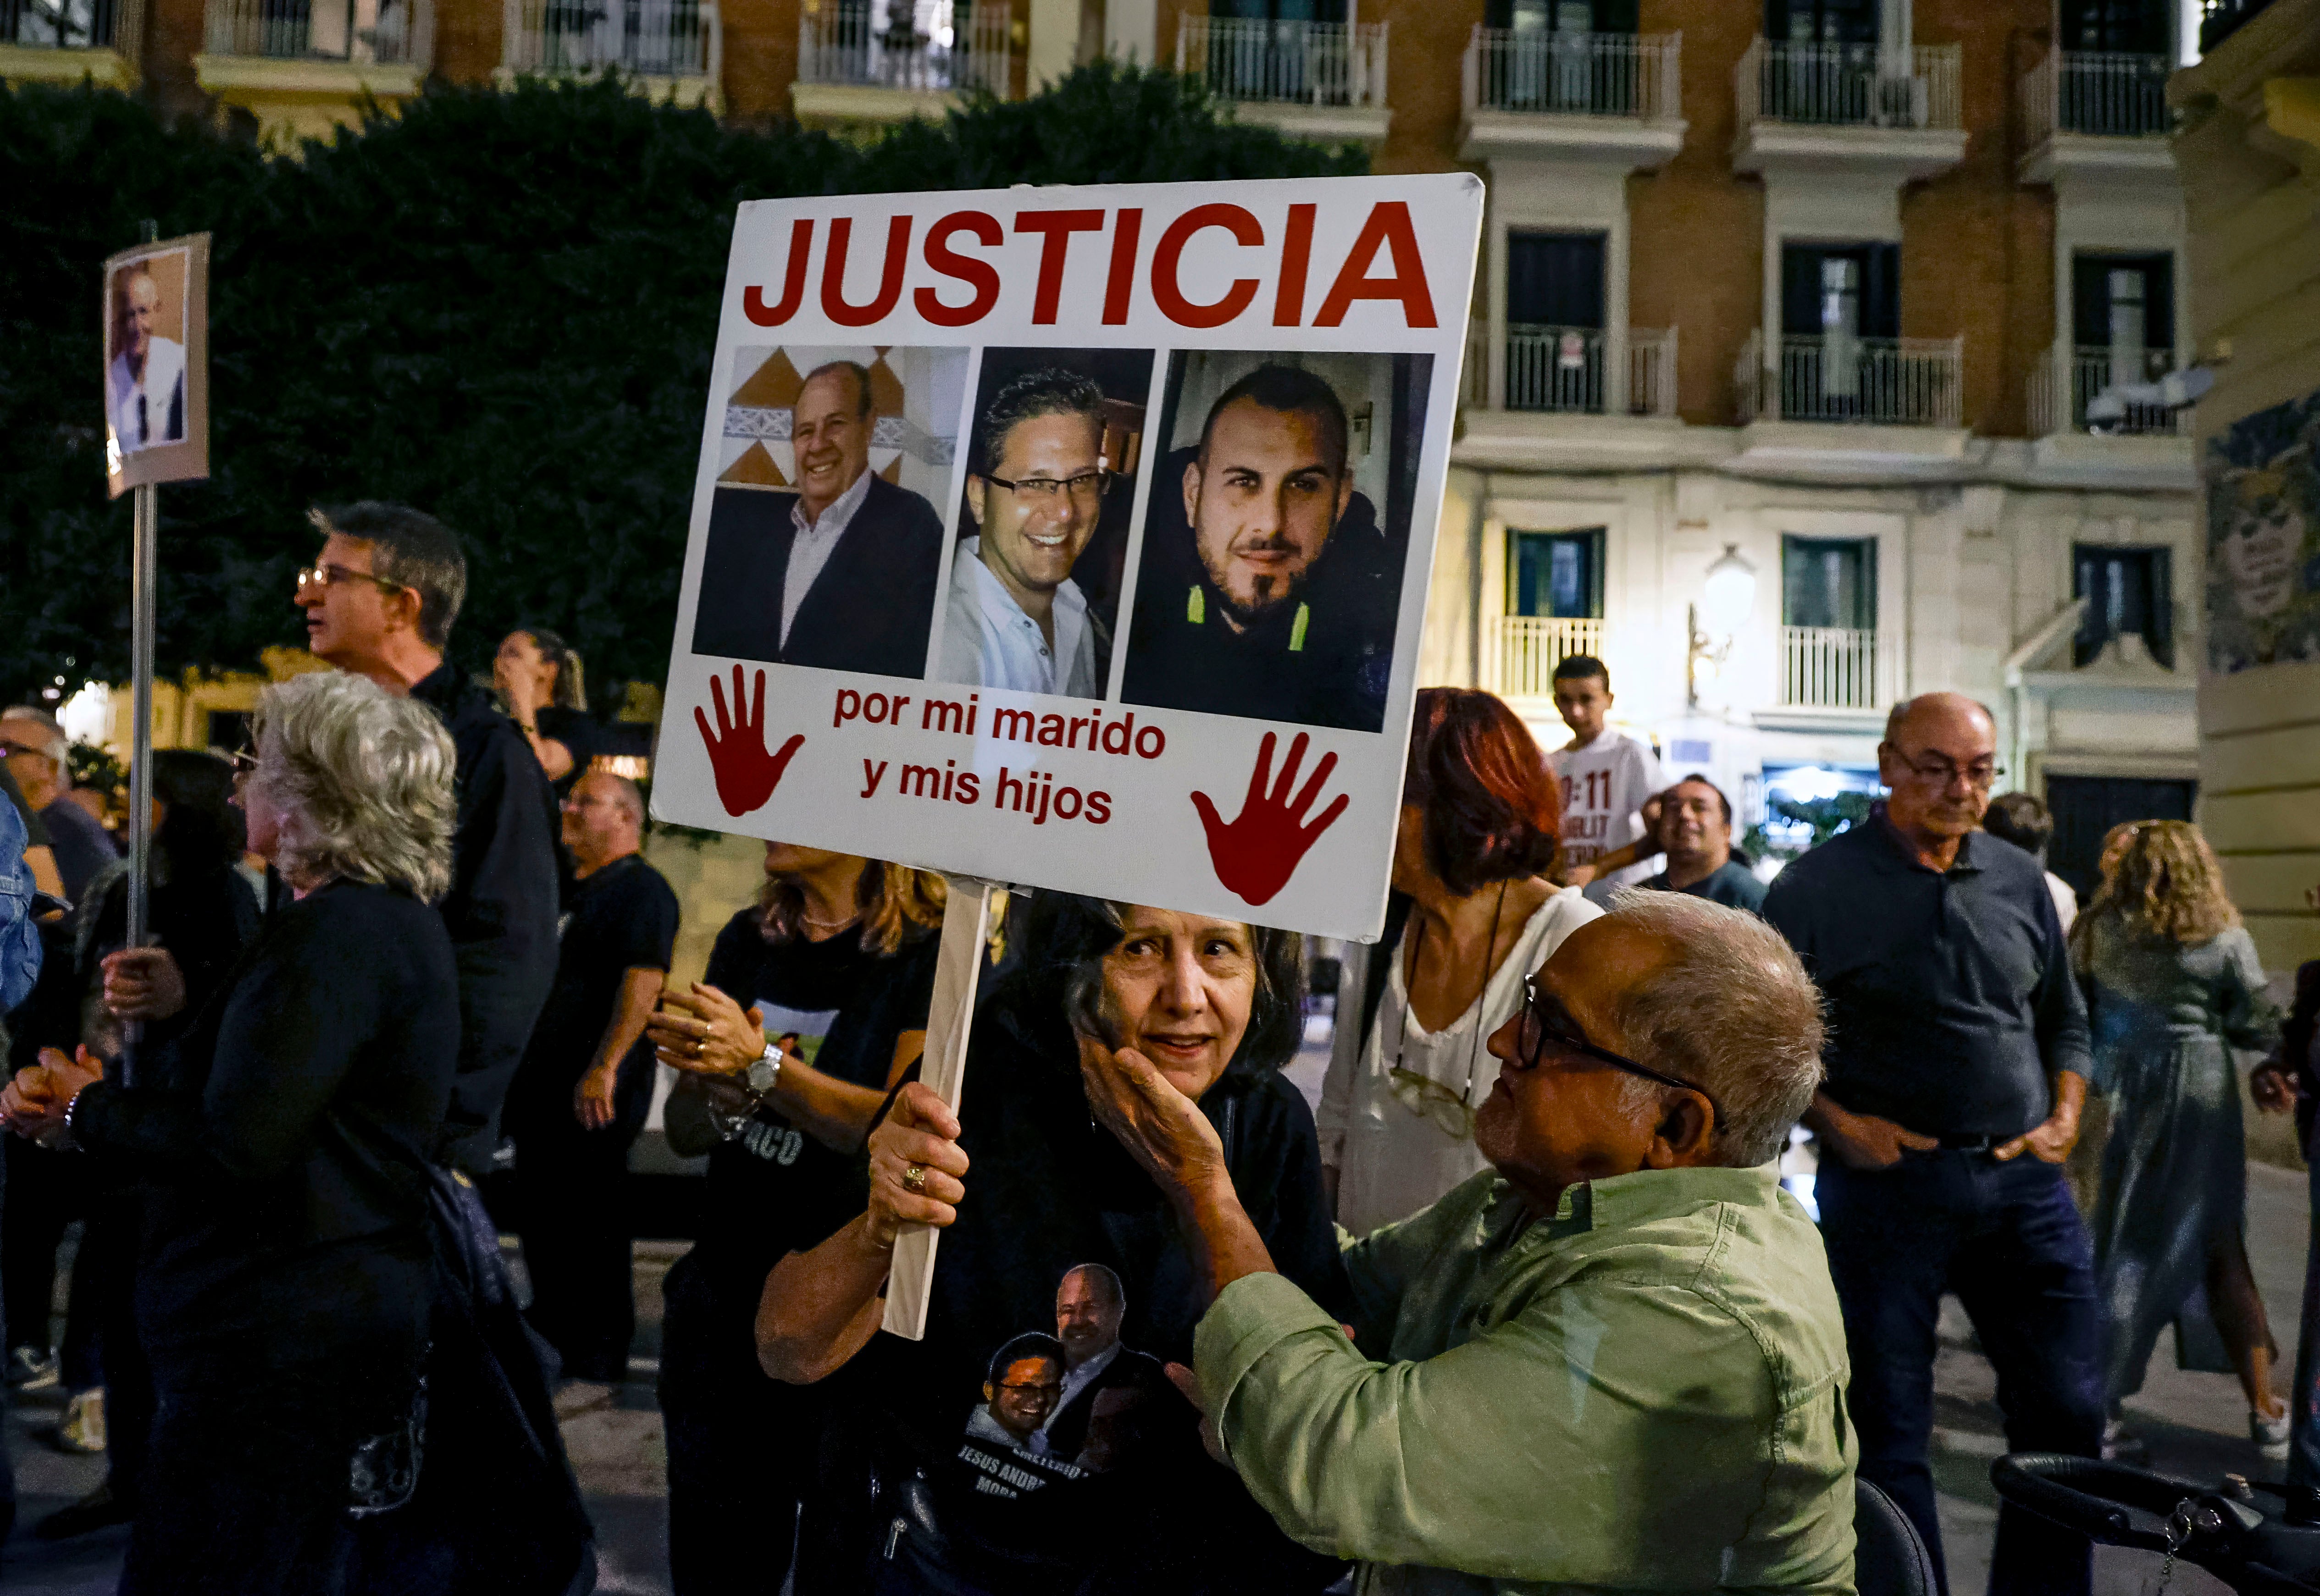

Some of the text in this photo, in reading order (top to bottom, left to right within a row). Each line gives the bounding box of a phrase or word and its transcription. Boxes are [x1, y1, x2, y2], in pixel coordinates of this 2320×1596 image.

[744, 202, 1437, 328] JUSTICIA
[834, 690, 1165, 759] por mi marido
[861, 759, 1111, 824] y mis hijos
[732, 1119, 803, 1166] ACO
[958, 1445, 1001, 1475] JESUS
